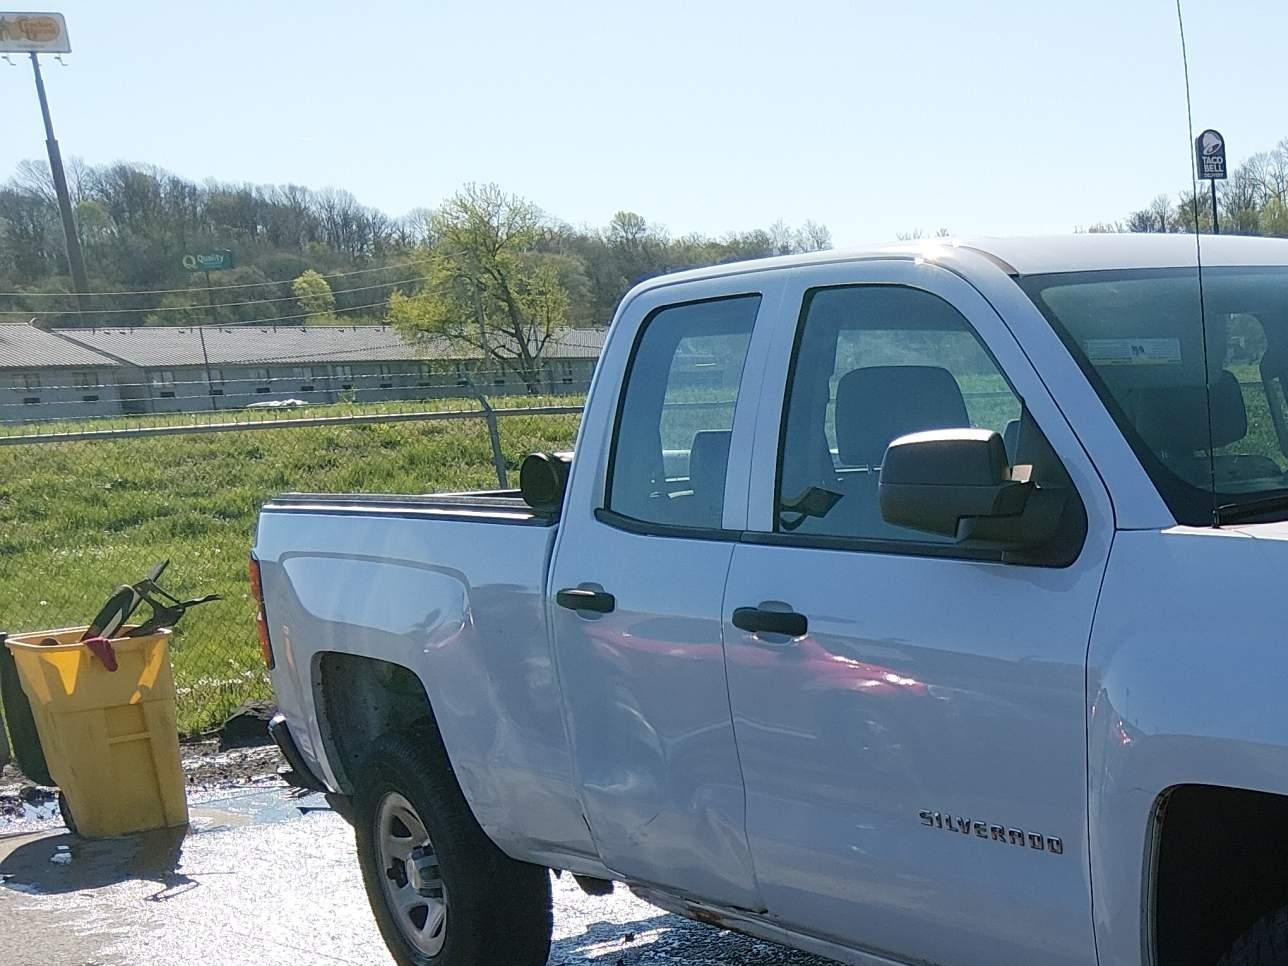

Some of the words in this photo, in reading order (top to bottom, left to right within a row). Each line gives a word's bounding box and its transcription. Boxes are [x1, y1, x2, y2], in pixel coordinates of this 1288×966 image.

[1201, 156, 1223, 165] TACO
[1203, 164, 1224, 172] BELL
[919, 808, 1064, 855] SILVERADO
